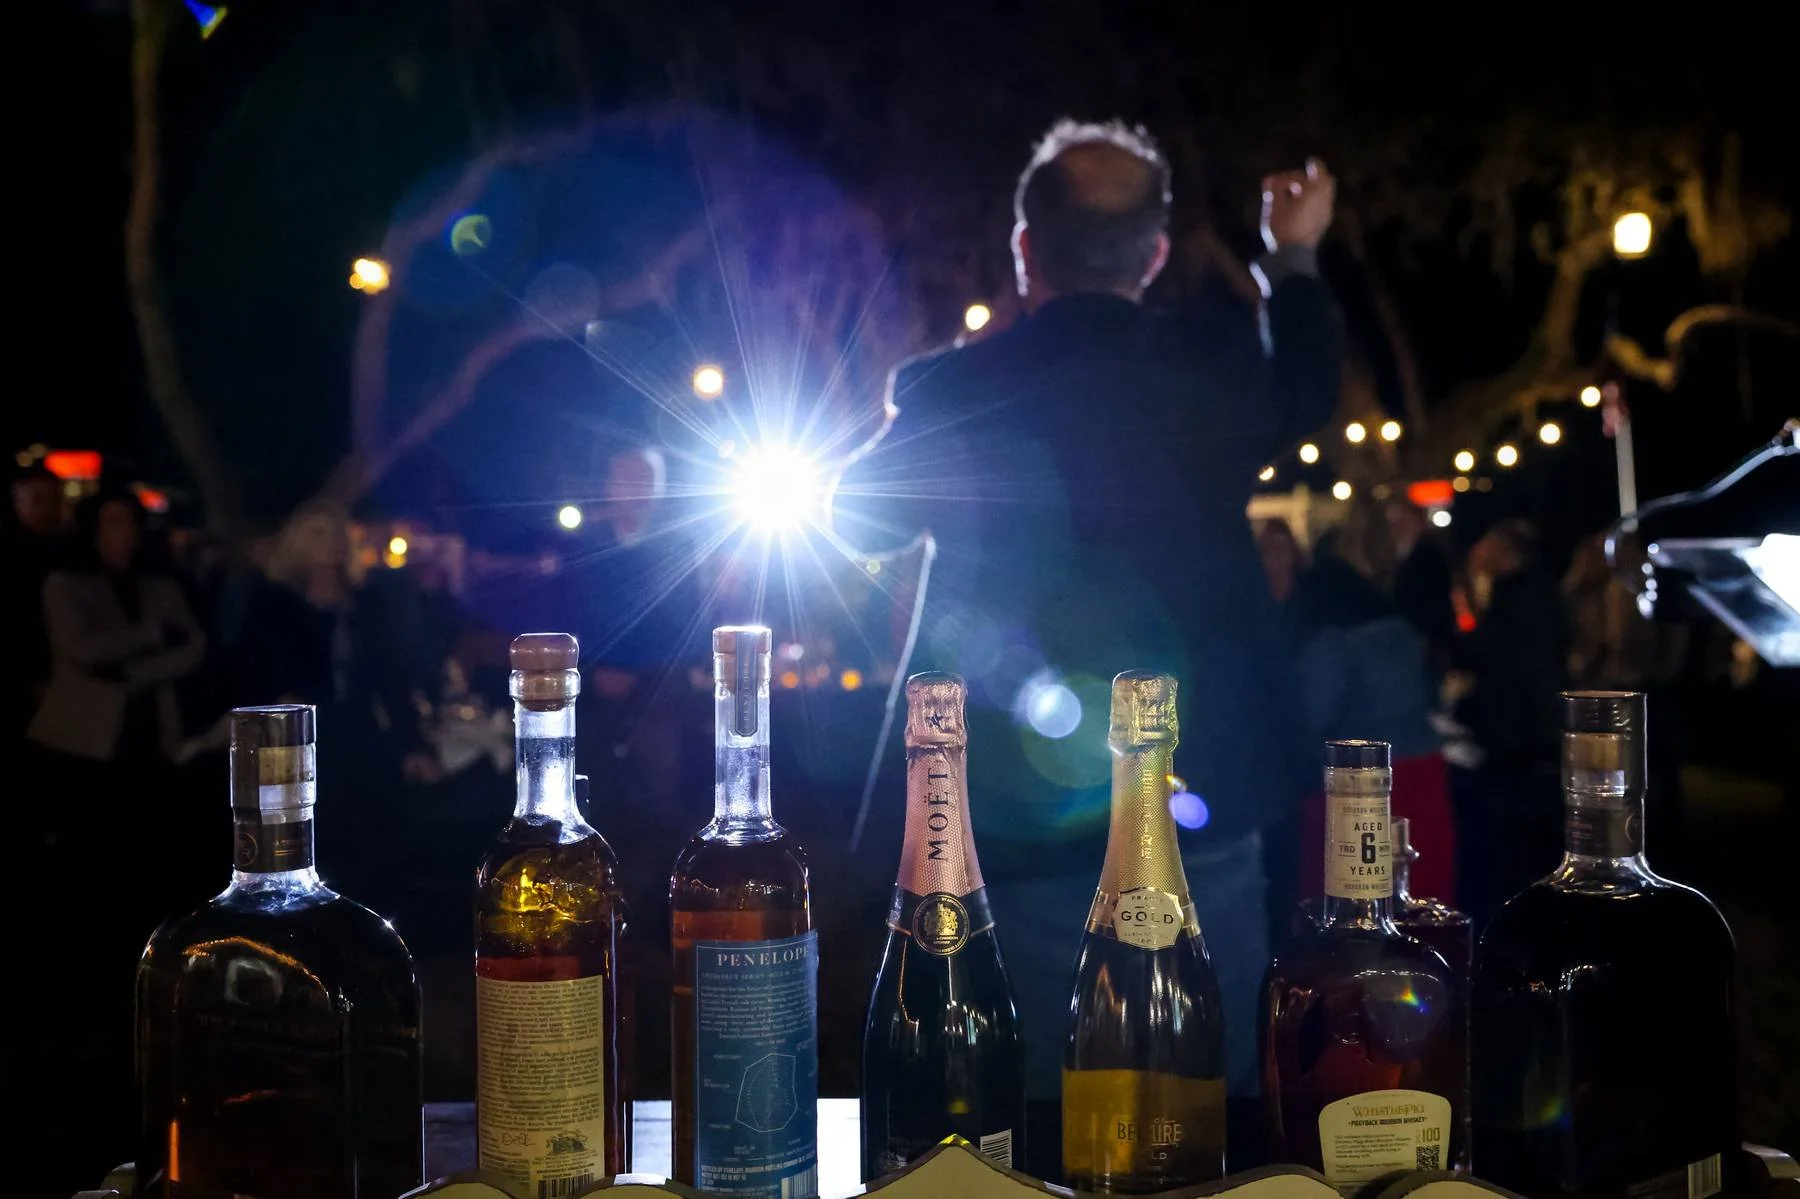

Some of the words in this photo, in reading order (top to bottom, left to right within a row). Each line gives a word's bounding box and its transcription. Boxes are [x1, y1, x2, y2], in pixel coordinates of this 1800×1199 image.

[923, 767, 950, 861] MOËT
[1354, 822, 1382, 831] AGED
[1361, 832, 1376, 864] 6
[1350, 866, 1385, 876] YEARS
[1120, 910, 1174, 925] GOLD
[1117, 1122, 1182, 1142] BEIRE
[1422, 1127, 1441, 1143] 100
